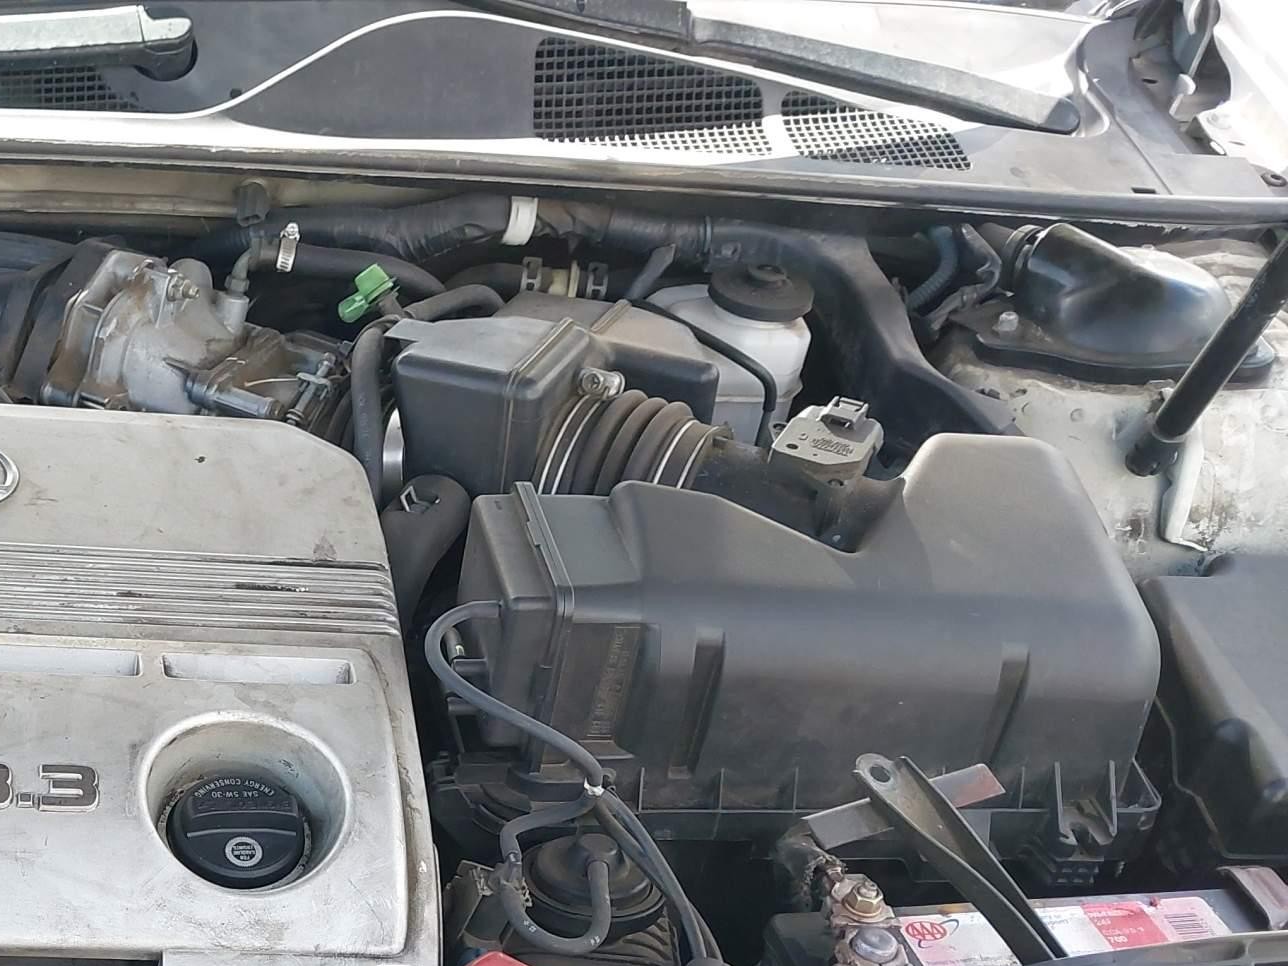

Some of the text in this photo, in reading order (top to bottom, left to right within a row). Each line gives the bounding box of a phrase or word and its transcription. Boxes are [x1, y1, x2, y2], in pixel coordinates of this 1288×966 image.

[194, 778, 275, 798] ENERGY CONSERVING
[211, 790, 259, 799] SAE 5W-30
[905, 921, 947, 941] AAA
